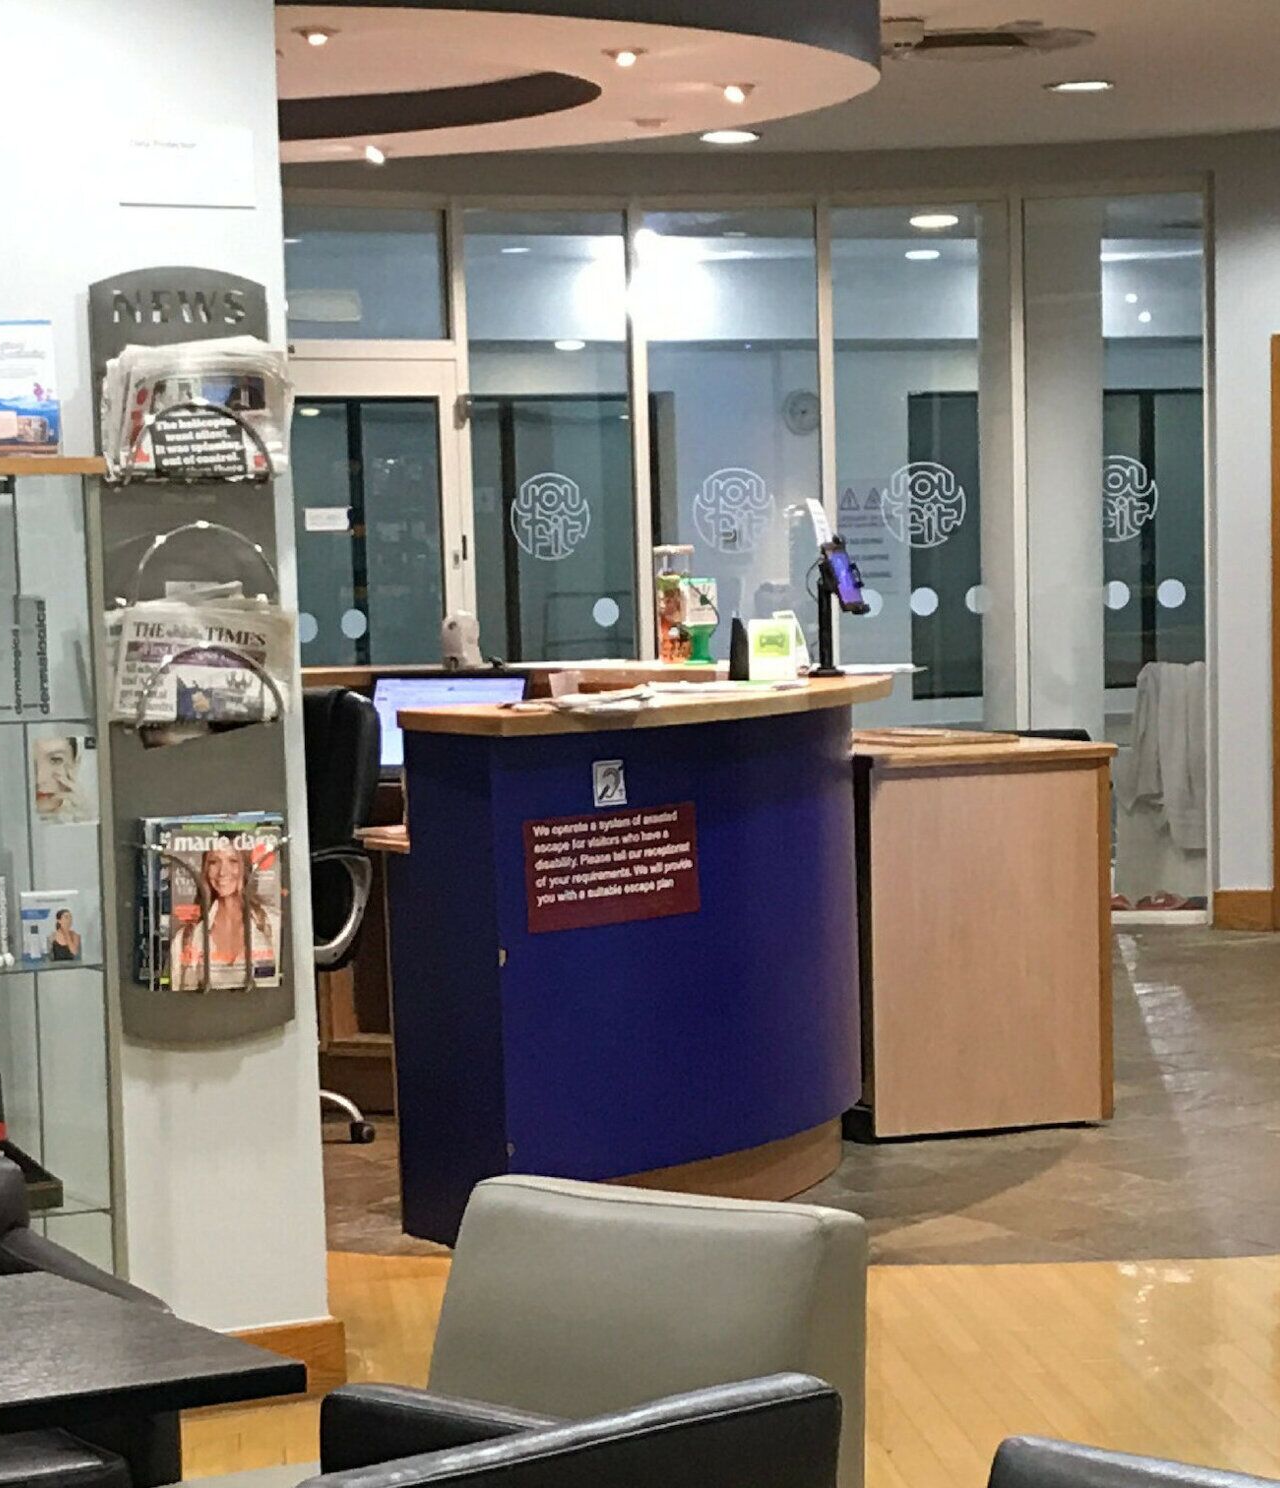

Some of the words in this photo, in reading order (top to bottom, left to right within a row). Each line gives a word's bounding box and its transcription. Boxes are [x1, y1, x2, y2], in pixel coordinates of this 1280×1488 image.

[113, 290, 246, 323] NEWS
[133, 622, 165, 637] THE
[205, 626, 267, 646] TIMES
[35, 599, 50, 715] dermalogica
[533, 825, 550, 837] We
[552, 822, 588, 836] operate
[599, 818, 630, 832] system
[632, 815, 641, 825] of
[173, 831, 230, 852] marie
[534, 842, 569, 853] escape
[572, 839, 585, 850] for
[588, 836, 619, 848] visitors
[622, 833, 639, 843] who
[641, 831, 661, 841] have
[580, 853, 611, 865] Please
[614, 850, 627, 861] tell
[629, 850, 642, 859] our
[644, 842, 690, 857] receptionist
[535, 877, 547, 888] of
[549, 876, 569, 888] your
[633, 865, 648, 875] We
[650, 862, 663, 873] will
[664, 859, 693, 873] provide
[536, 894, 555, 907] you
[558, 890, 577, 901] with
[579, 890, 585, 899] a
[587, 884, 622, 898] suitable
[624, 880, 655, 893] escape
[656, 879, 674, 891] plan
